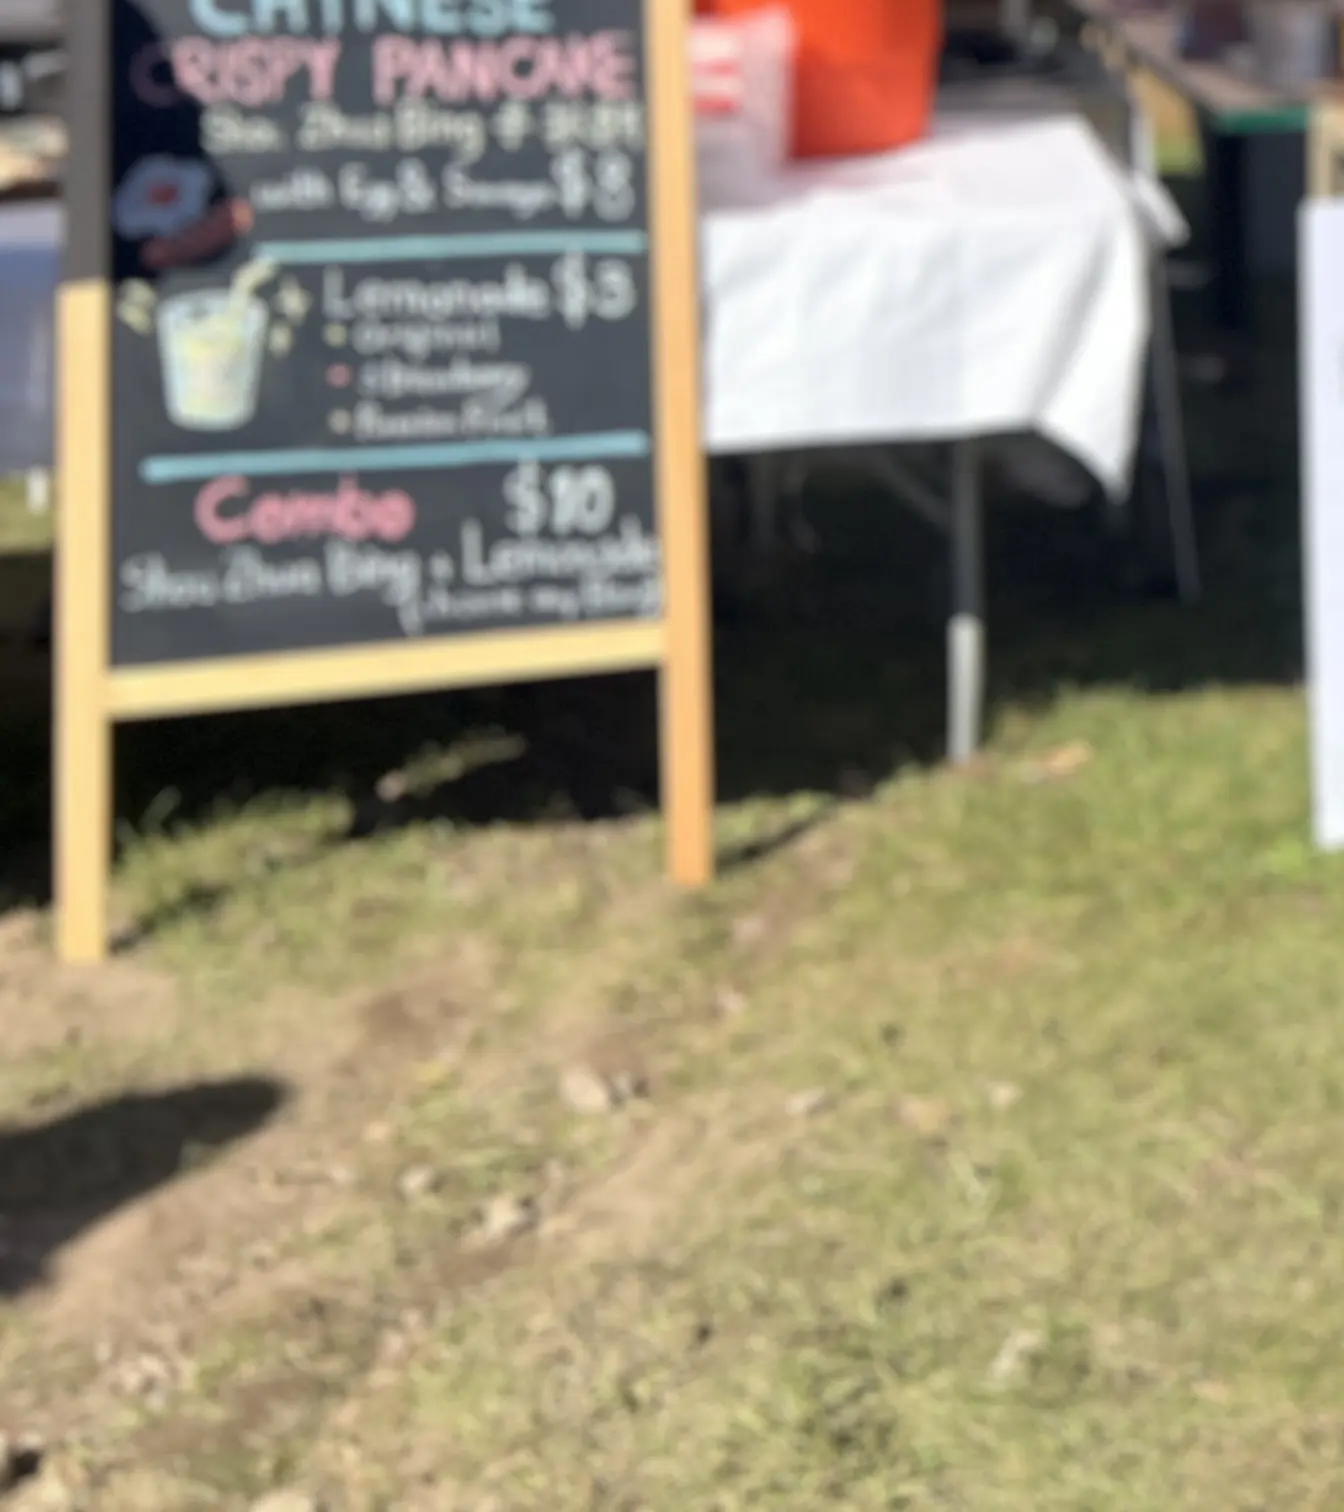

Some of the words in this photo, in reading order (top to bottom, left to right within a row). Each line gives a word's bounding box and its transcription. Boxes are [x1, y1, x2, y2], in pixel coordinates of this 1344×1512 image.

[130, 36, 341, 105] CRISPY
[372, 30, 637, 101] PANCAKE
[249, 166, 334, 210] with
[550, 146, 636, 223] $8
[322, 264, 549, 319] Lemonade
[194, 474, 416, 544] Combo
[503, 458, 616, 536] $10
[461, 516, 660, 588] Lemonade
